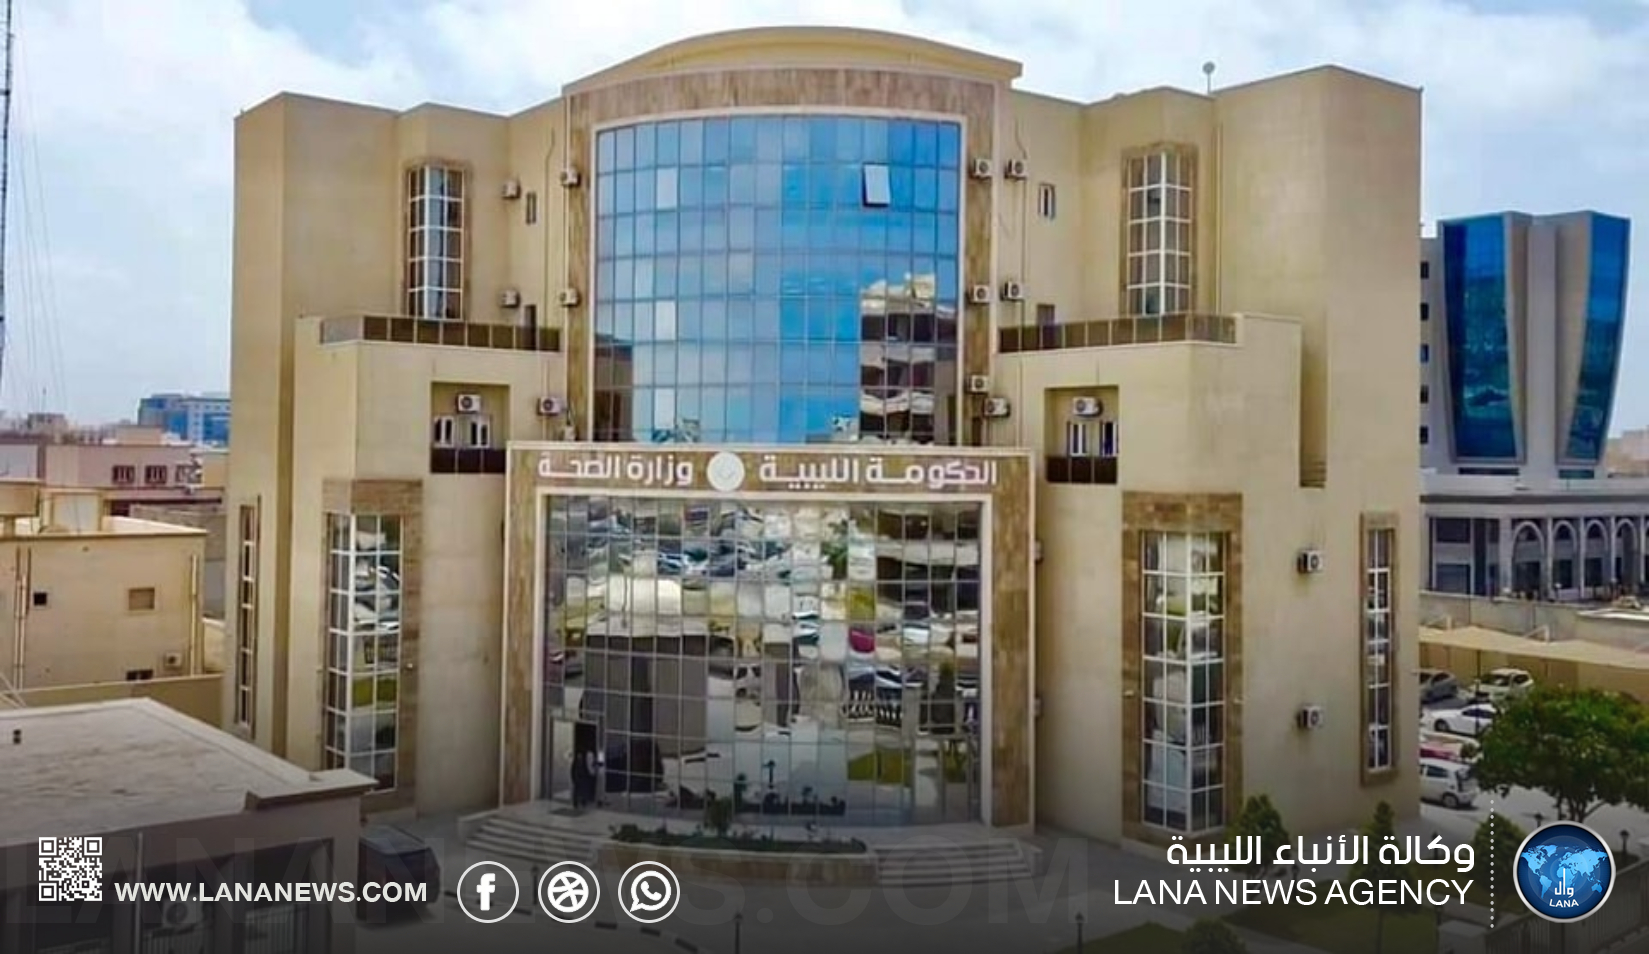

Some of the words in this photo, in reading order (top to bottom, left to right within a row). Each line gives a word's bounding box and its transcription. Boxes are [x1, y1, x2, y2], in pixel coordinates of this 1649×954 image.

[538, 452, 620, 479] الصحة
[627, 454, 693, 486] وزارة
[759, 454, 859, 490] الليبية
[866, 456, 998, 489] الحكومة
